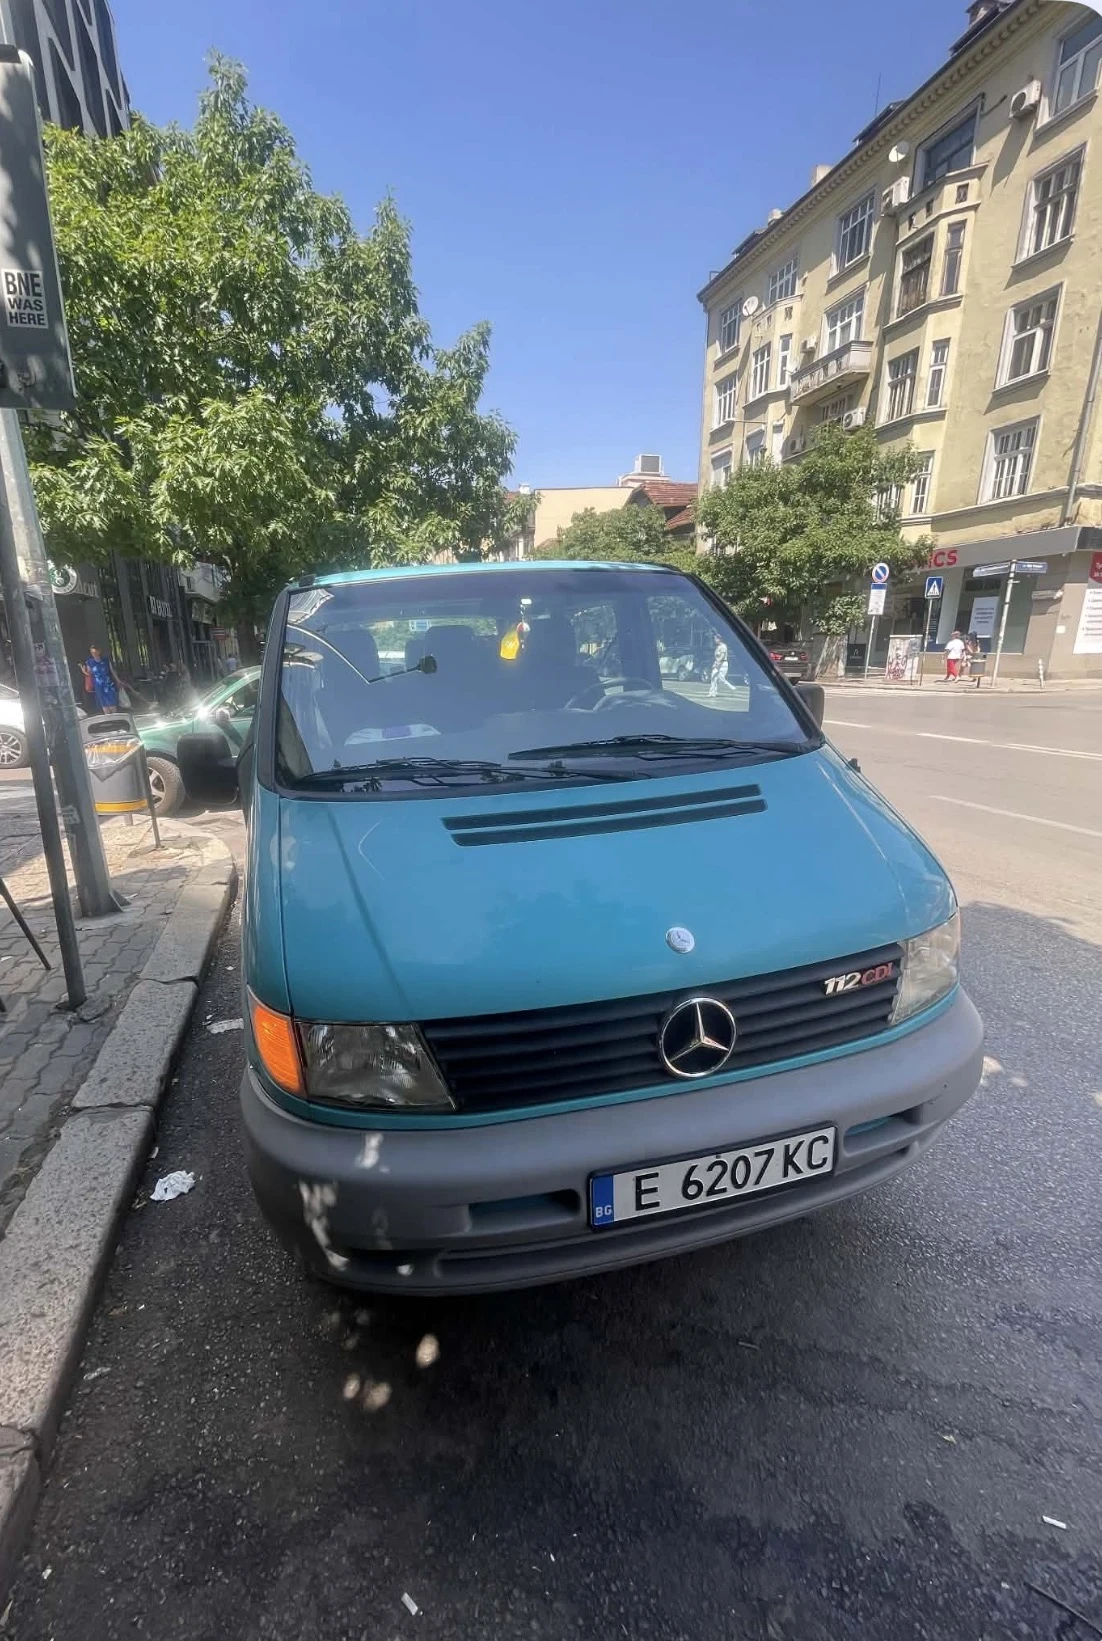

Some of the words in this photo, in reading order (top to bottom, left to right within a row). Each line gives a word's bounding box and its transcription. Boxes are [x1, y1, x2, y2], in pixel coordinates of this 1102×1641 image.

[5, 271, 42, 297] BNE
[8, 298, 44, 311] WAS
[9, 311, 46, 325] HERE
[634, 1172, 660, 1211] E
[681, 1148, 775, 1201] 6207
[783, 1134, 829, 1178] KC
[595, 1205, 613, 1218] BG
